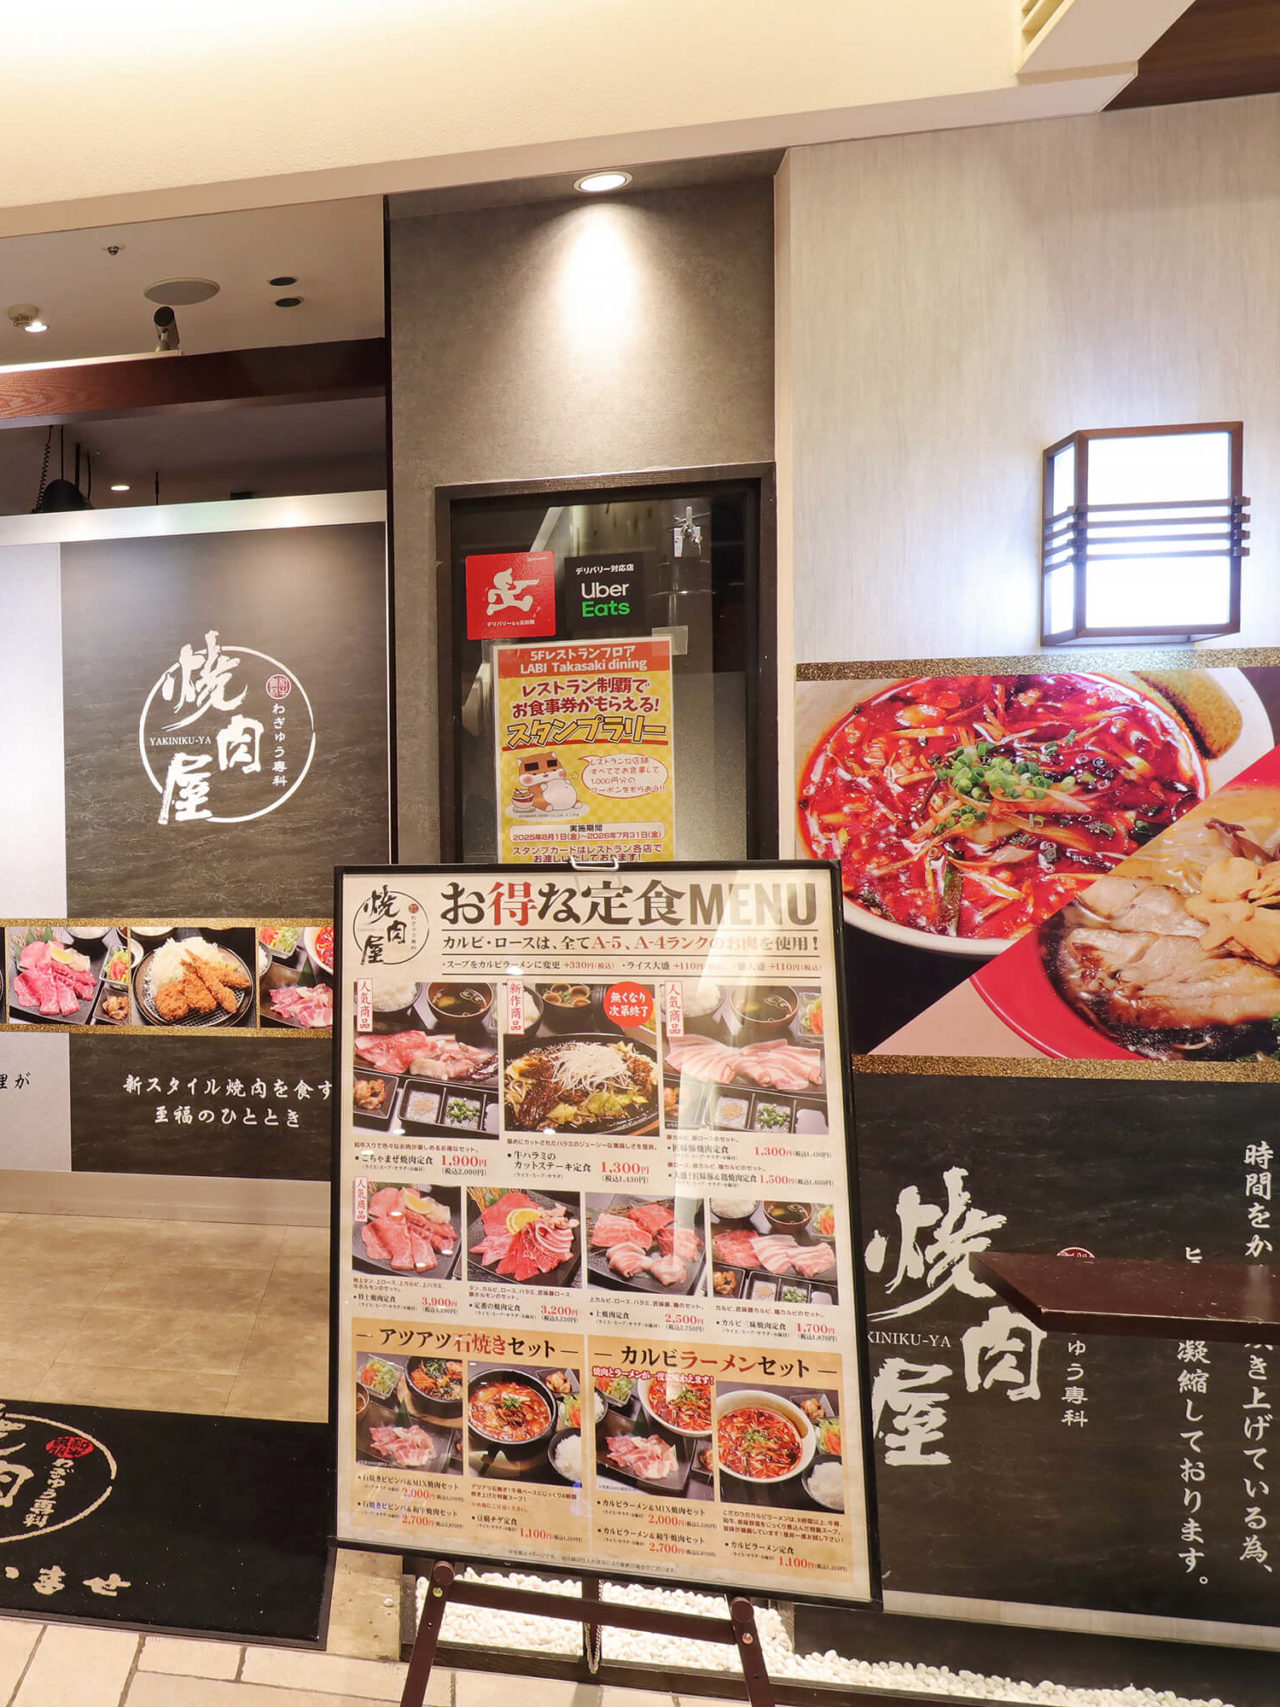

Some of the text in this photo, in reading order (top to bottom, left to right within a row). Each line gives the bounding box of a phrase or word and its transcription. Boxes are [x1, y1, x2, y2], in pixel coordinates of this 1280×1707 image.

[575, 563, 635, 575] デリバリー対応店
[581, 582, 630, 599] Uber
[582, 600, 631, 618] Eats
[530, 645, 636, 662] 5Fレストランフロア
[520, 658, 647, 674] LABI Takasaki dining
[522, 677, 650, 698] レストラン制覇で
[507, 714, 667, 748] スタンプラリー
[149, 736, 212, 746] YAKINIKU-YA
[570, 824, 603, 832] 実施期間
[440, 879, 817, 927] お得な定食MENU
[627, 960, 670, 970] ライス大盛
[610, 991, 647, 1003] 無くなり
[359, 982, 370, 1030] 人気商品
[510, 983, 522, 1031] 新作商品
[609, 1005, 649, 1018] 次第終了
[667, 983, 682, 1035] 人気商品
[122, 1074, 333, 1100] 新スタイル焼肉を食す
[154, 1105, 300, 1128] 至福のひととき
[513, 1161, 591, 1173] カットステーキ定食
[379, 1328, 556, 1358] アツアツ石焼きセット
[867, 1331, 951, 1348] KINIKU-YA
[621, 1346, 810, 1378] カルビラーメンセット
[1061, 1340, 1089, 1428] ゅう専科
[731, 1541, 794, 1555] カルビラーメン定食
